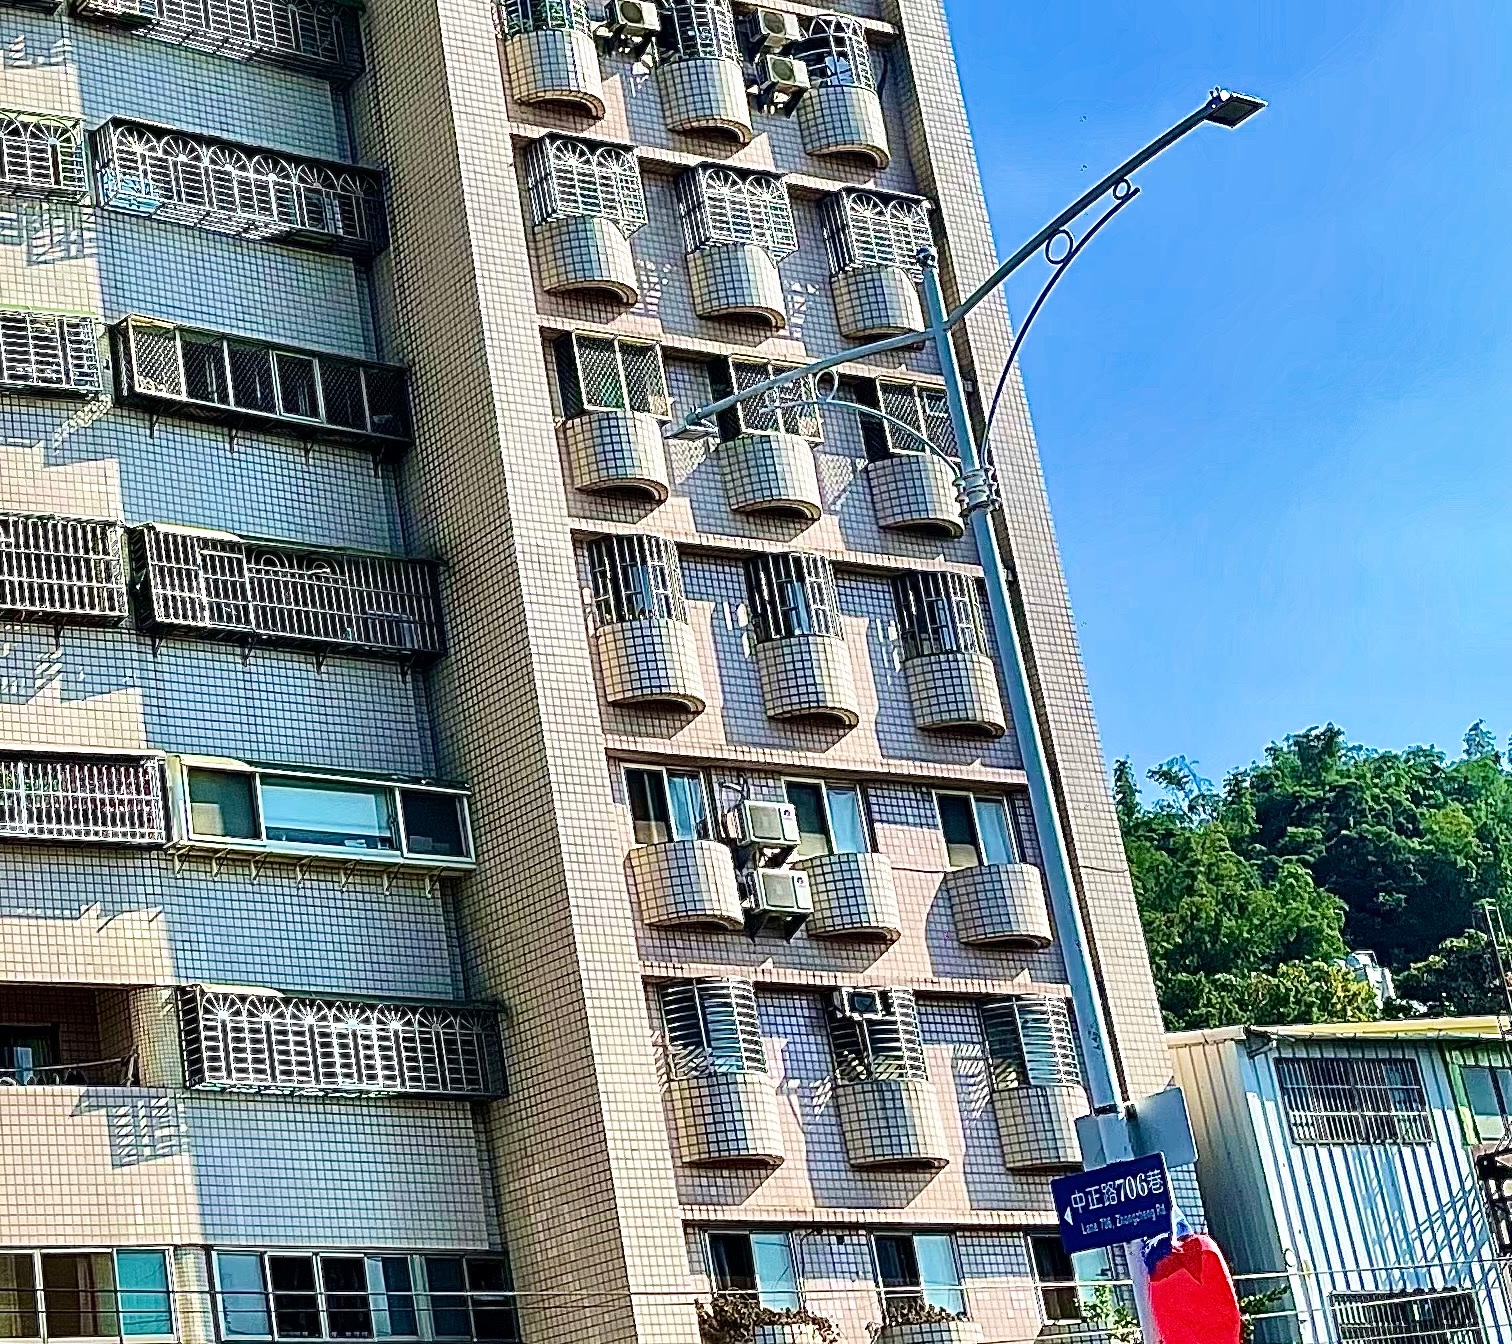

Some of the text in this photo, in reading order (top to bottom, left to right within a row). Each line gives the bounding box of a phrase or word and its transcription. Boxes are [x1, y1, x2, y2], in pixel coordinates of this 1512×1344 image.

[1071, 1169, 1164, 1213] 中正路706巷
[1081, 1222, 1099, 1235] Lane
